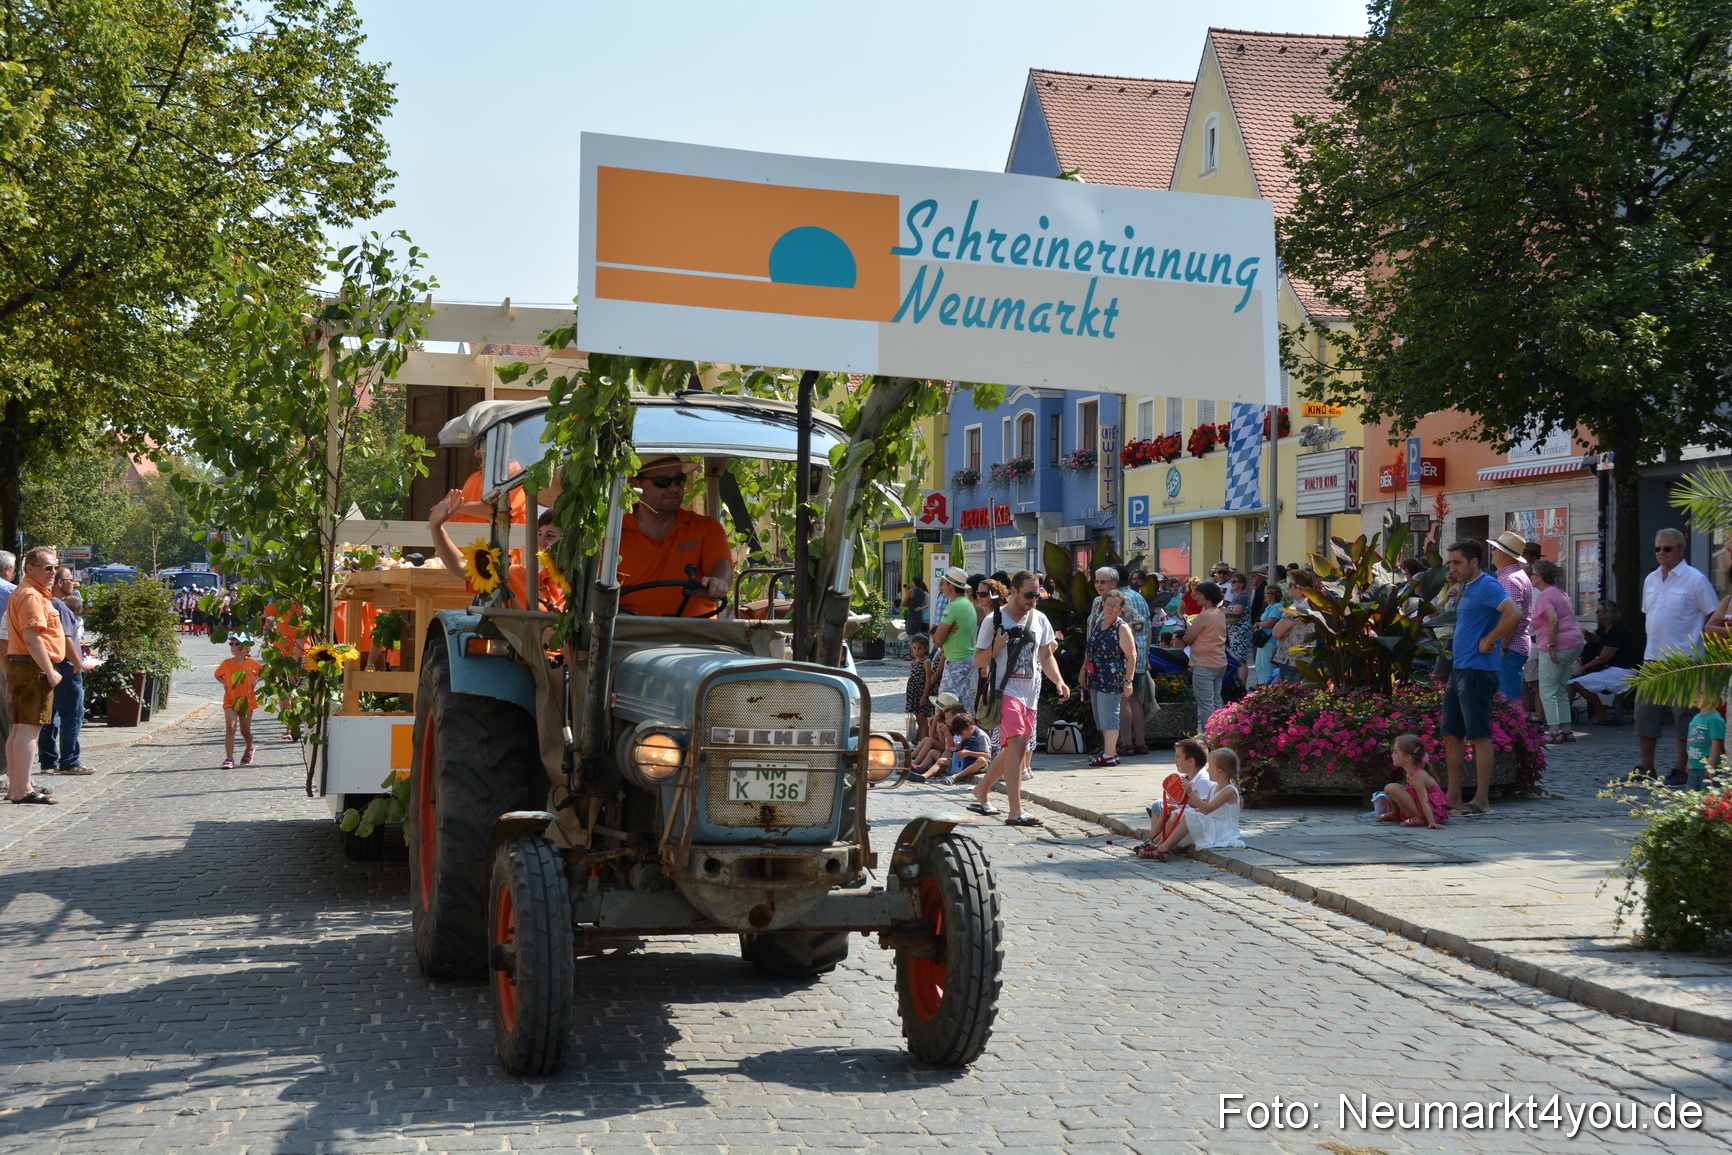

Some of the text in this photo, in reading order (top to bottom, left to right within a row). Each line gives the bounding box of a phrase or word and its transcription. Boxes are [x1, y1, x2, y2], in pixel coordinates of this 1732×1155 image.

[890, 198, 1261, 314] Schreinerinnung
[890, 264, 1119, 339] Neumarkt
[1307, 405, 1327, 415] KINO
[1409, 443, 1418, 475] P
[1103, 441, 1115, 504] WITTL
[1324, 474, 1338, 487] KINO
[1348, 450, 1357, 508] KINO
[1380, 473, 1393, 488] DER
[959, 504, 1011, 530] APOTHKE
[1132, 499, 1145, 524] P
[711, 727, 837, 745] EICHER
[756, 763, 788, 781] NM
[736, 781, 799, 799] K 136
